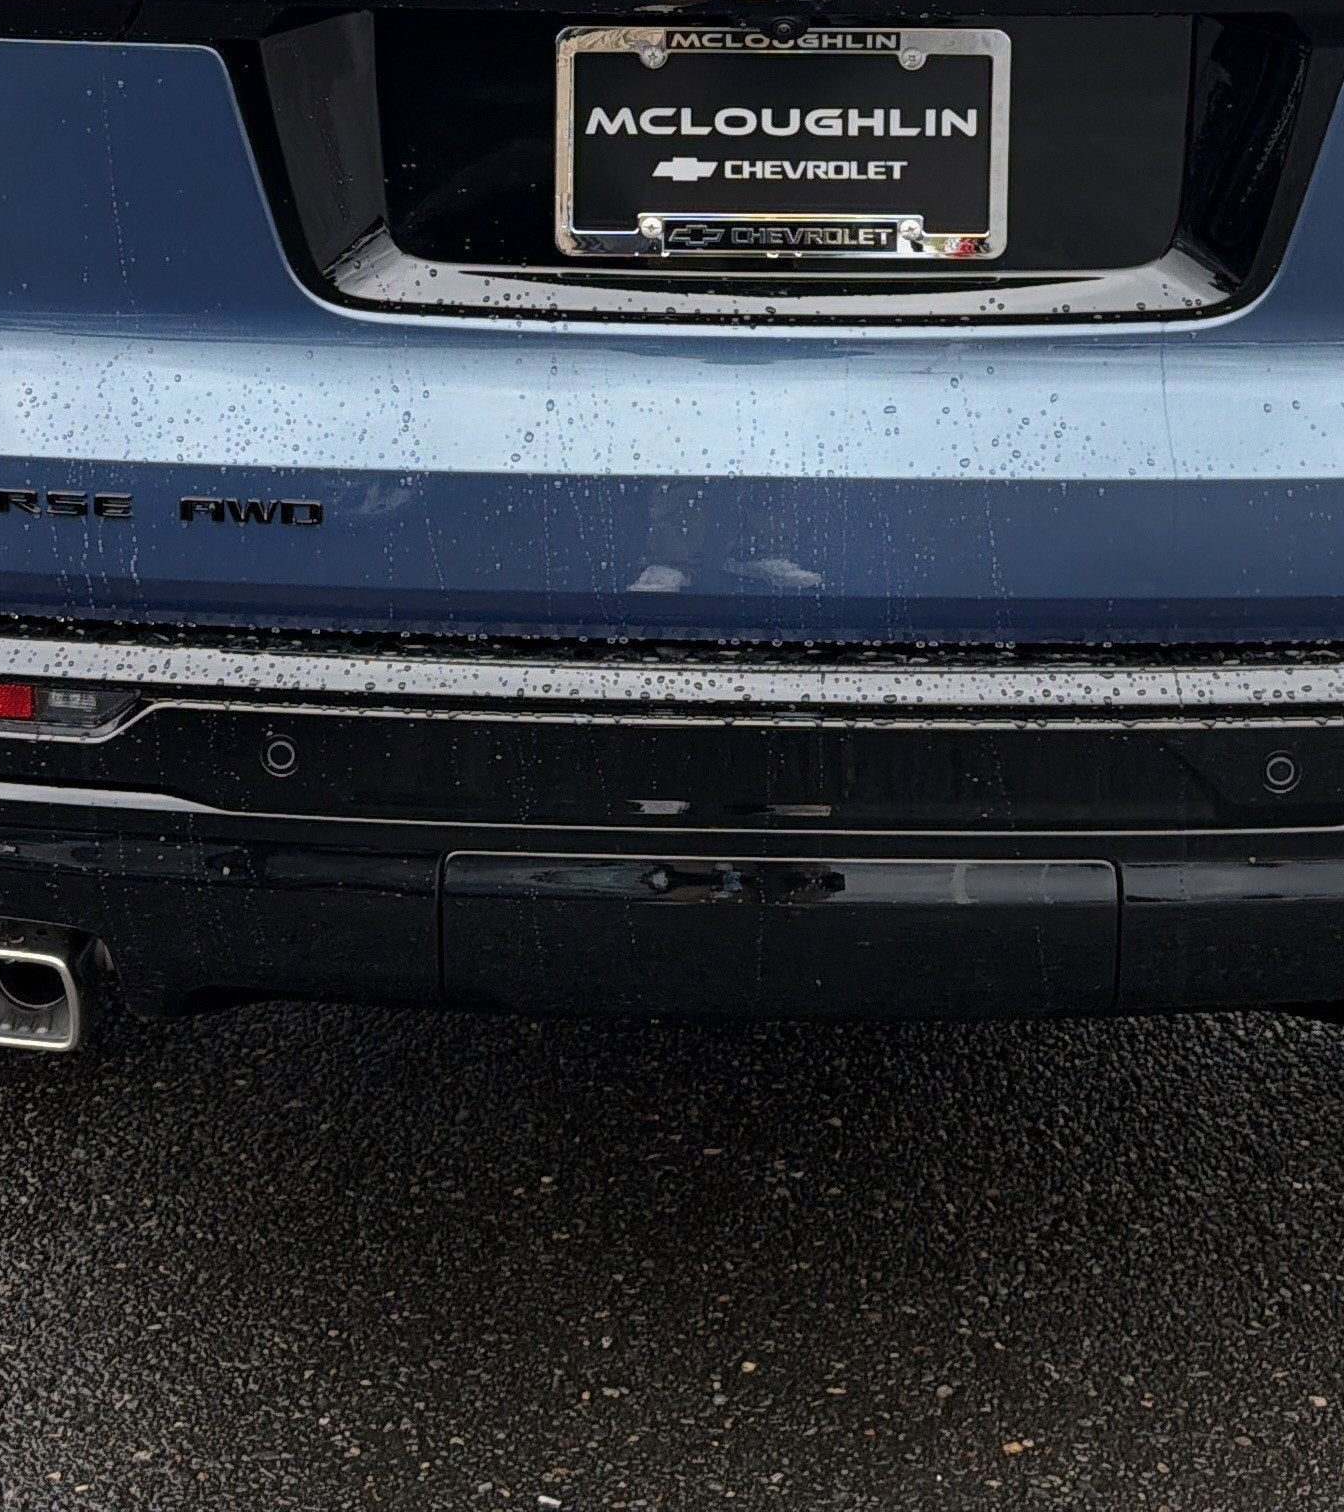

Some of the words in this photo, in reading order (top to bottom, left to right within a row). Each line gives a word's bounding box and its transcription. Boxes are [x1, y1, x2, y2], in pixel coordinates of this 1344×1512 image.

[585, 107, 978, 136] MCLOUGHLIN
[724, 160, 908, 180] CHEVROLET
[731, 227, 893, 245] CHEVROLET
[179, 495, 324, 526] AWD
